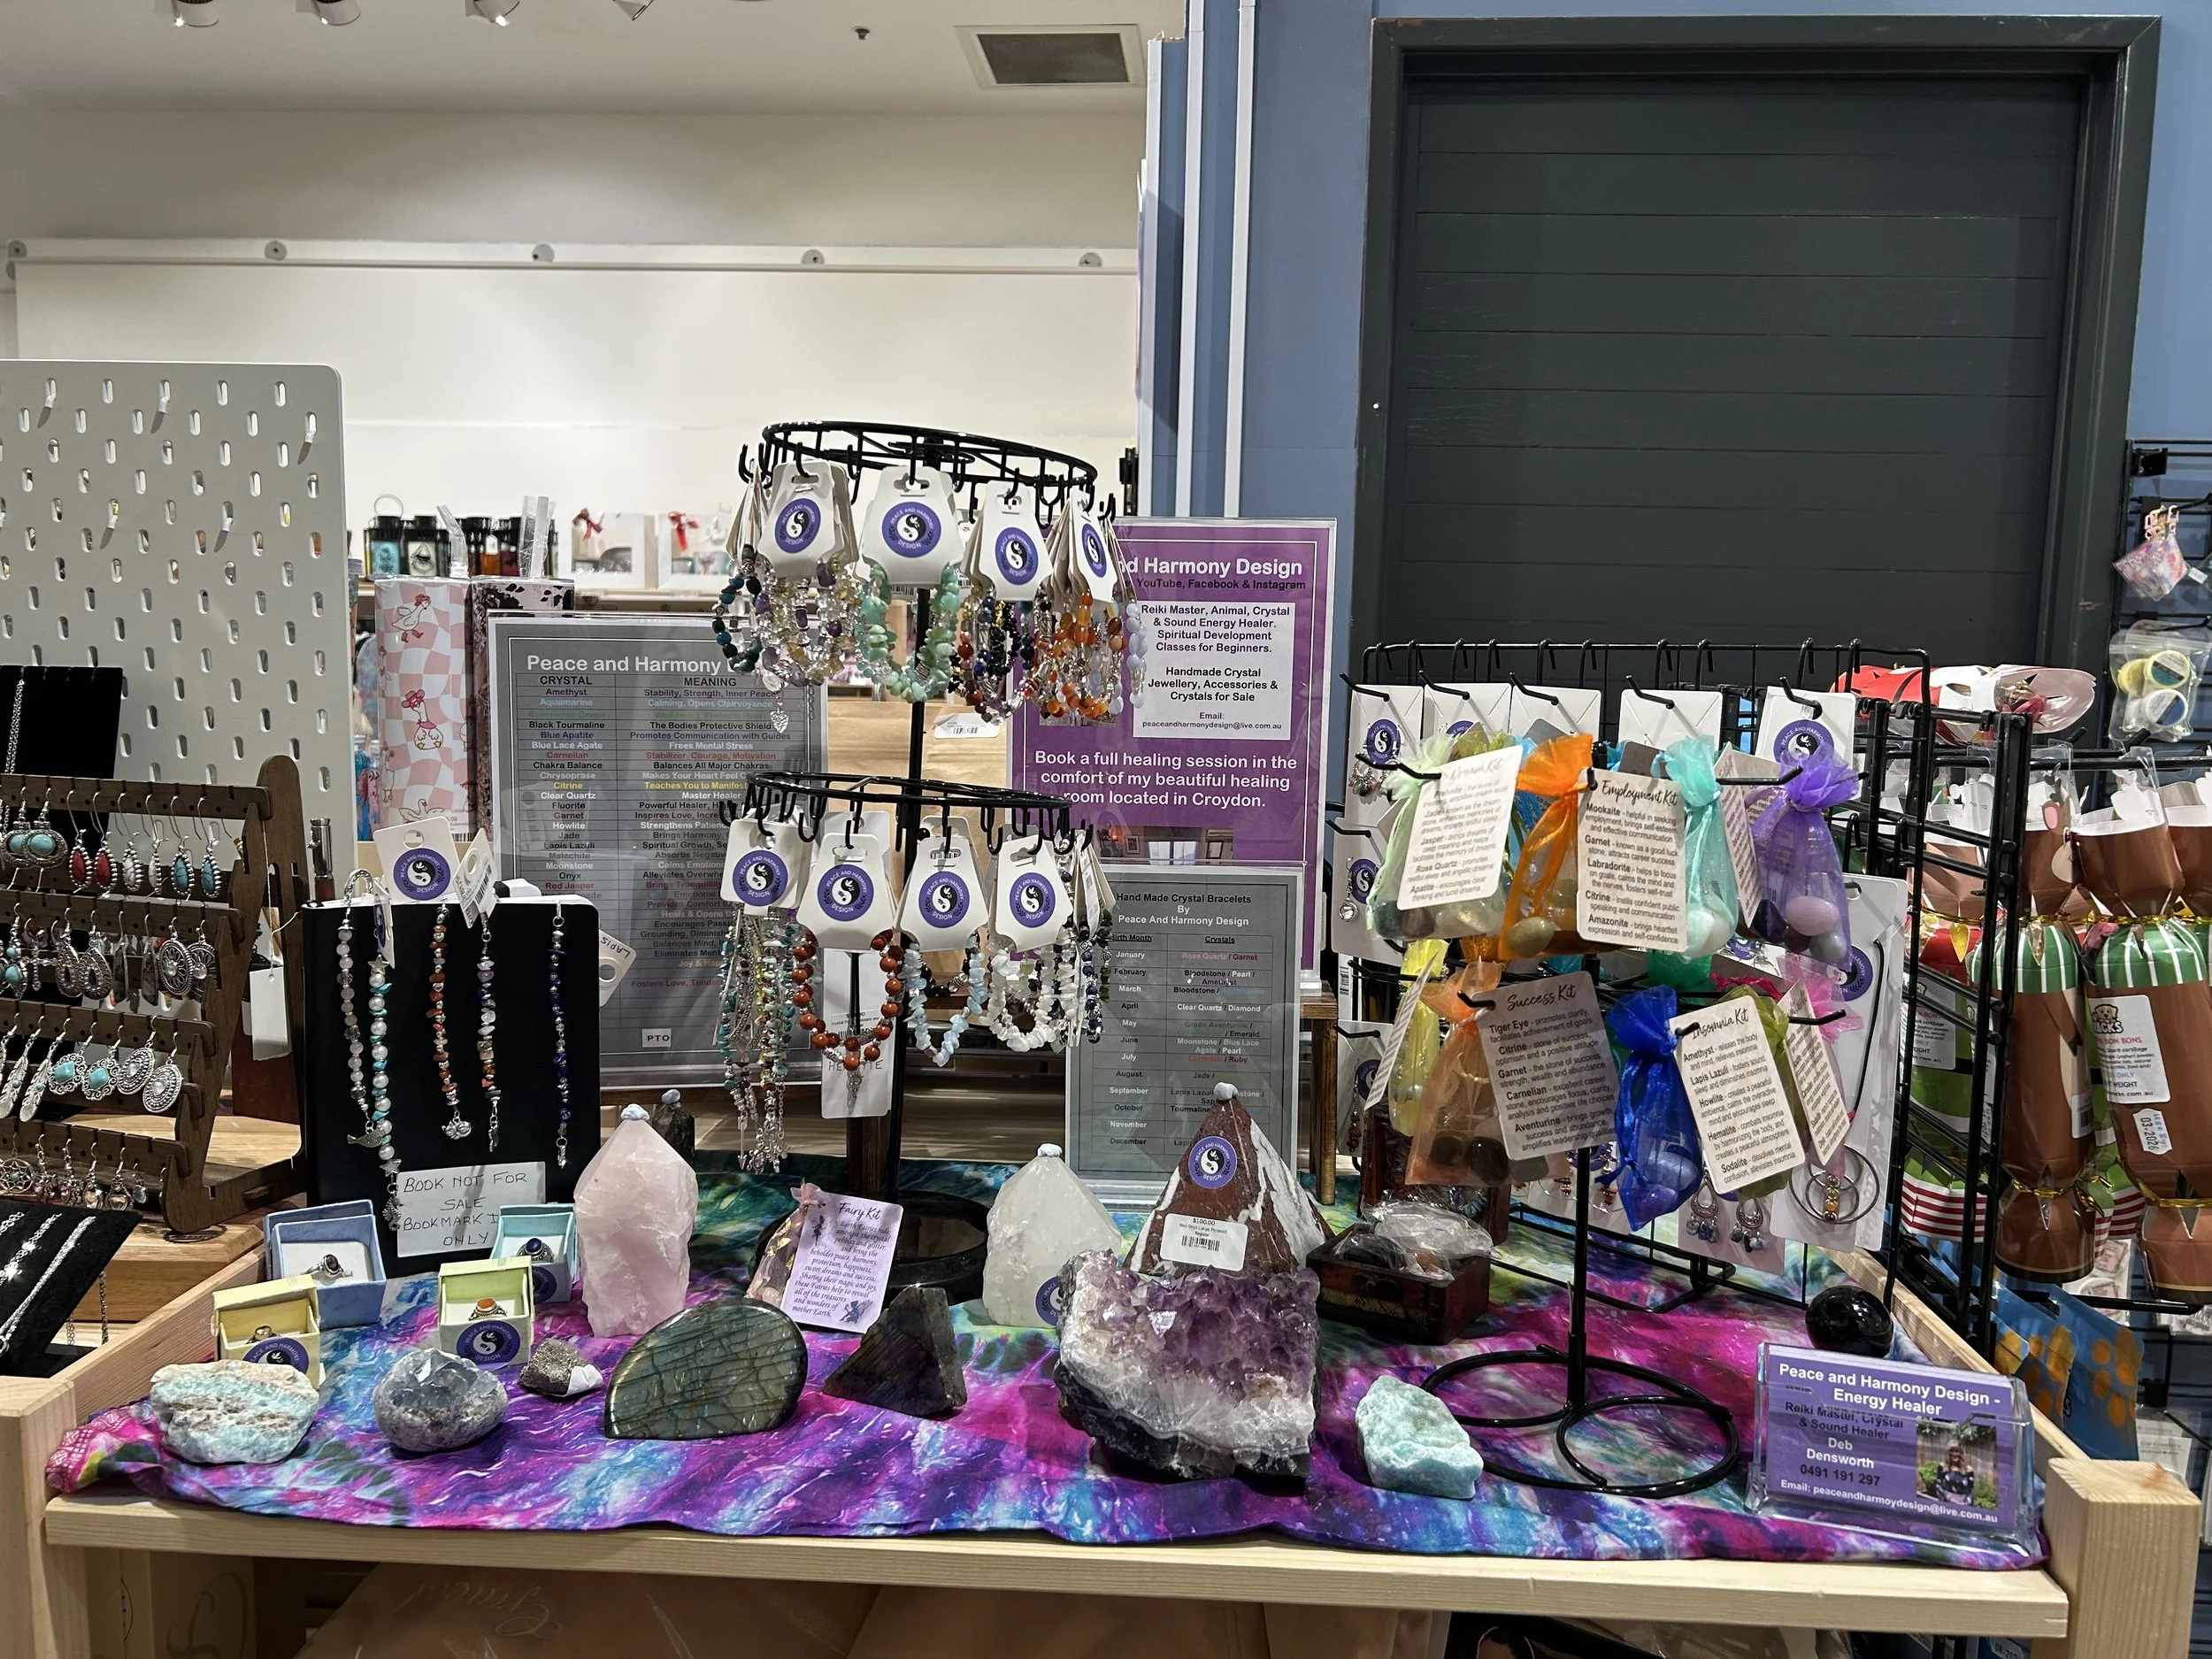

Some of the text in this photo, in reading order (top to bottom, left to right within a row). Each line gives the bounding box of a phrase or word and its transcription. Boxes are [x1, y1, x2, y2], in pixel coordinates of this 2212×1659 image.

[1144, 557, 1231, 579] Harmony
[1236, 559, 1302, 579] Design
[1137, 580, 1306, 590] YouTube, Facebook & Instagram
[1141, 605, 1290, 618] Reiki Master, Animal, Crystal
[1200, 618, 1236, 629] Energy
[1239, 619, 1277, 628] Healer.
[1158, 630, 1272, 642] Spiritual Development
[1156, 642, 1195, 651] Classes
[1217, 643, 1272, 654] Beginners.
[527, 655, 721, 676] Peace and Harmony
[1165, 667, 1261, 678] Handmade Crystal
[540, 676, 592, 685] CRYSTAL
[684, 678, 736, 687] MEANING
[1148, 680, 1201, 689] Jewellery,
[1203, 680, 1267, 689] Accessories
[546, 688, 588, 697] Amethyst
[1170, 692, 1255, 702] Crystals for Sale
[1142, 721, 1282, 730] peaceandharmonydesign@live.com.au
[1035, 751, 1297, 770] Book a full healing session in the
[1041, 772, 1290, 791] comfort of my beautiful healing
[1602, 780, 1678, 806] Employment Kit
[1064, 791, 1266, 810] room located in Croydon.
[1586, 803, 1621, 816] Mookaite
[1585, 835, 1610, 847] Garnet
[741, 859, 752, 875] PEACE
[764, 857, 780, 876] HARMONY
[1434, 860, 1457, 871] Quartz
[1587, 859, 1631, 872] Labradorite
[558, 872, 581, 881] Onyx
[1171, 895, 1204, 903] Crystal
[1586, 891, 1610, 902] Citrine
[1177, 905, 1190, 915] By
[1171, 917, 1214, 926] Harmony
[1217, 918, 1248, 926] Design
[1588, 915, 1629, 927] Amazonite
[600, 936, 630, 959] LAPIS
[1507, 985, 1578, 1011] Success Kit
[1489, 1020, 1529, 1033] Tiger Eye
[1692, 1008, 1749, 1040] Insomnia Kit
[647, 1033, 670, 1042] PTO
[1499, 1043, 1527, 1055] Citrine
[1684, 1046, 1714, 1063] Amethyst
[1498, 1066, 1527, 1079] Garnet
[1690, 1066, 1729, 1086] Lapis Lazuli
[1507, 1087, 1547, 1101] Carnelian
[1699, 1094, 1724, 1108] Howlite
[1515, 1118, 1561, 1133] Aventurine
[1708, 1126, 1737, 1141] Hematite
[2140, 1118, 2160, 1150] 03.2026
[1721, 1157, 1748, 1173] Sodalite
[403, 1171, 527, 1193] BOOK NOT FOR
[440, 1196, 488, 1210] SALE
[839, 1202, 882, 1221] Fairy Kit
[442, 1232, 488, 1246] ONLY
[822, 1267, 842, 1276] dreams
[1779, 1363, 1824, 1381] Peace
[1828, 1371, 1856, 1385] and
[1861, 1375, 1931, 1399] Harmony
[1935, 1386, 1990, 1405] Design
[1833, 1388, 1942, 1416] Energy Healer
[1785, 1402, 1903, 1429] Reiki Master, Crystal
[1799, 1417, 1889, 1440] & Sound Healer
[1828, 1437, 1853, 1451] Deb
[1807, 1448, 1875, 1469] Densworth
[1800, 1464, 1880, 1486] 0491 191 297
[1781, 1479, 1811, 1493] Email:
